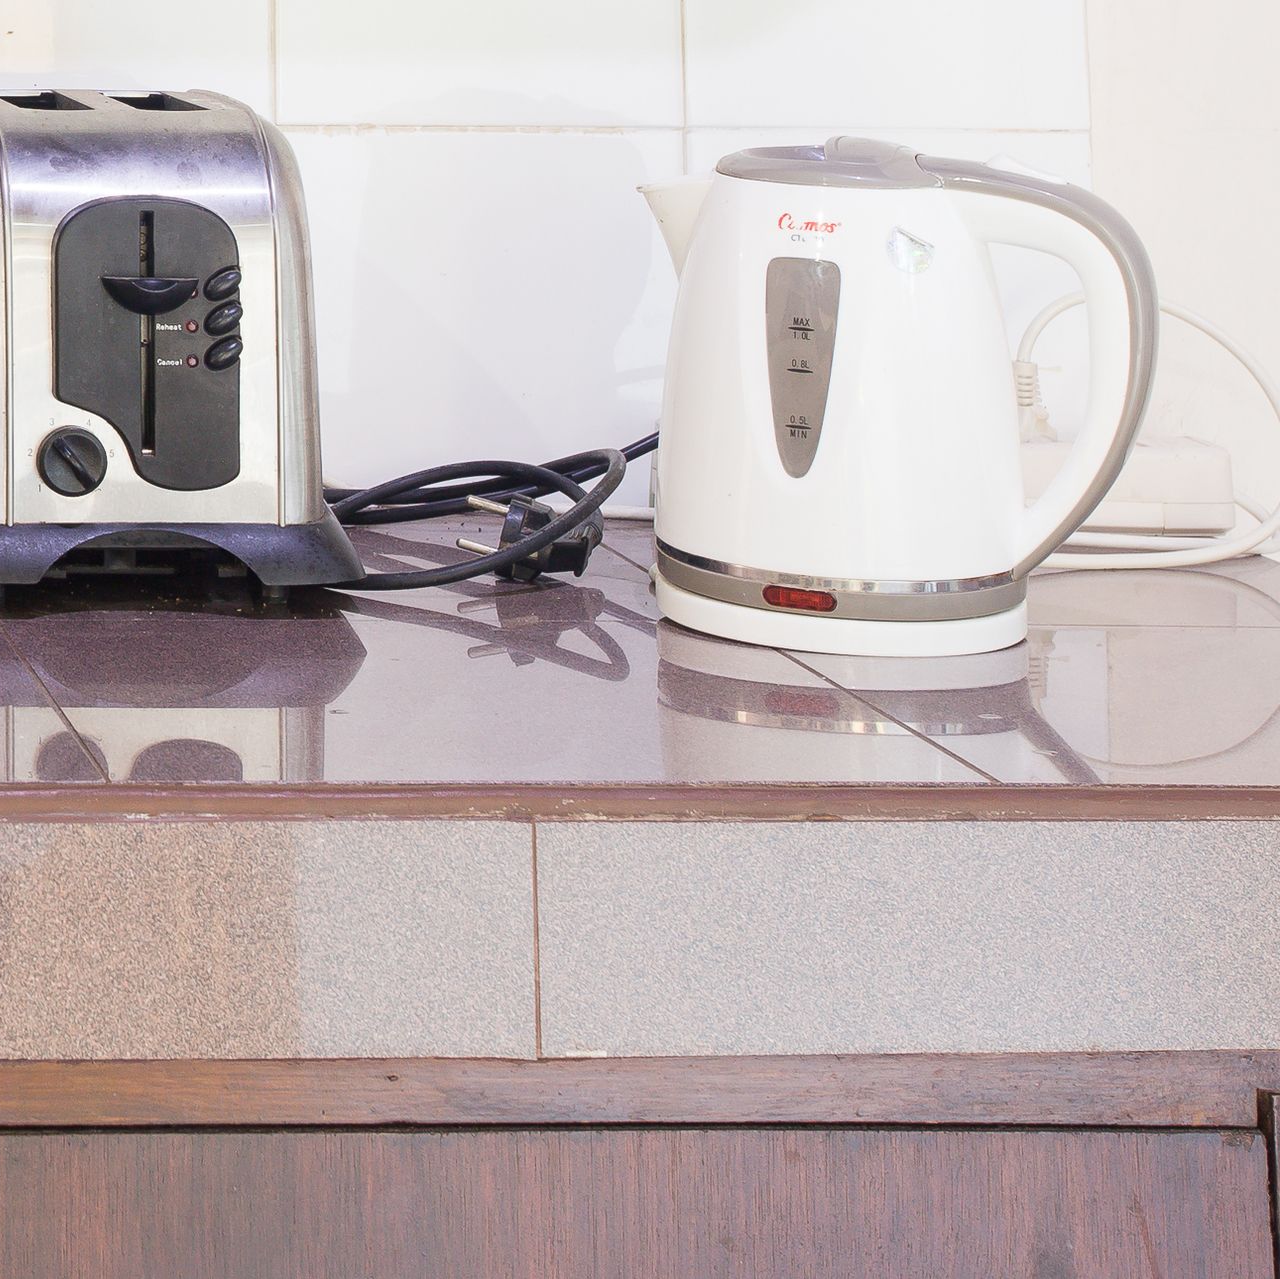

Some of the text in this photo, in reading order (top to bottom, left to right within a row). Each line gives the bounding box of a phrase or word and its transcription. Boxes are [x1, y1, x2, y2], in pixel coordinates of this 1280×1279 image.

[792, 316, 811, 328] MAX
[155, 323, 182, 332] Reheat
[156, 358, 183, 367] Cancel
[789, 428, 808, 440] MIN
[27, 448, 33, 457] 2
[109, 449, 115, 458] 5
